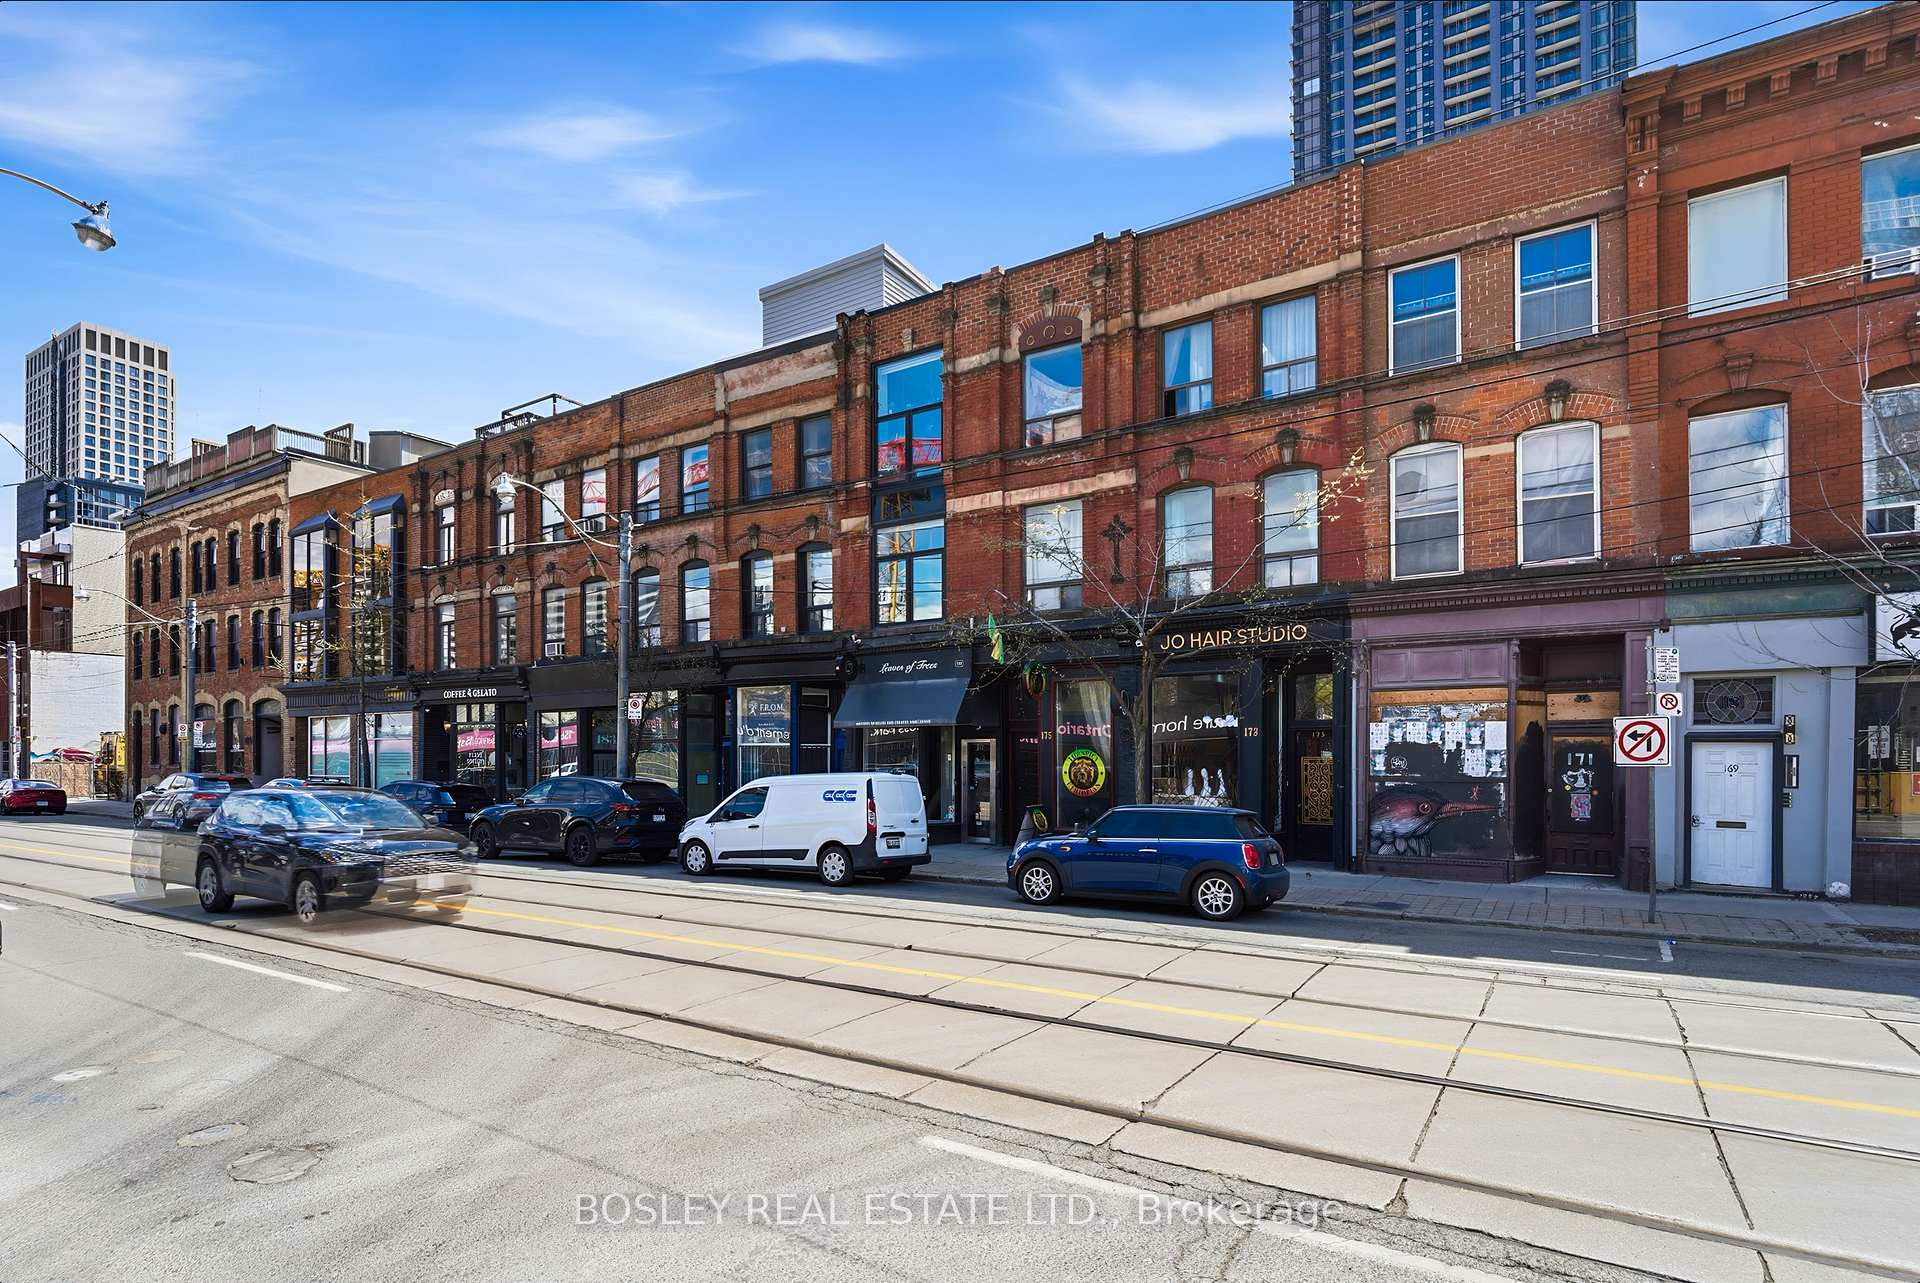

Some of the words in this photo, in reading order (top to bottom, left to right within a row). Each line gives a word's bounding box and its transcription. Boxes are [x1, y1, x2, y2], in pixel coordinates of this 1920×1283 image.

[1160, 634, 1185, 650] JO
[1190, 630, 1232, 648] HAIR
[1237, 625, 1307, 644] STUDIO
[879, 662, 904, 674] Leaves
[904, 660, 917, 674] of
[916, 660, 938, 670] Trees
[443, 689, 467, 699] COFFEE
[472, 688, 497, 698] GELATO
[1041, 731, 1053, 740] 175
[1567, 752, 1593, 765] 171
